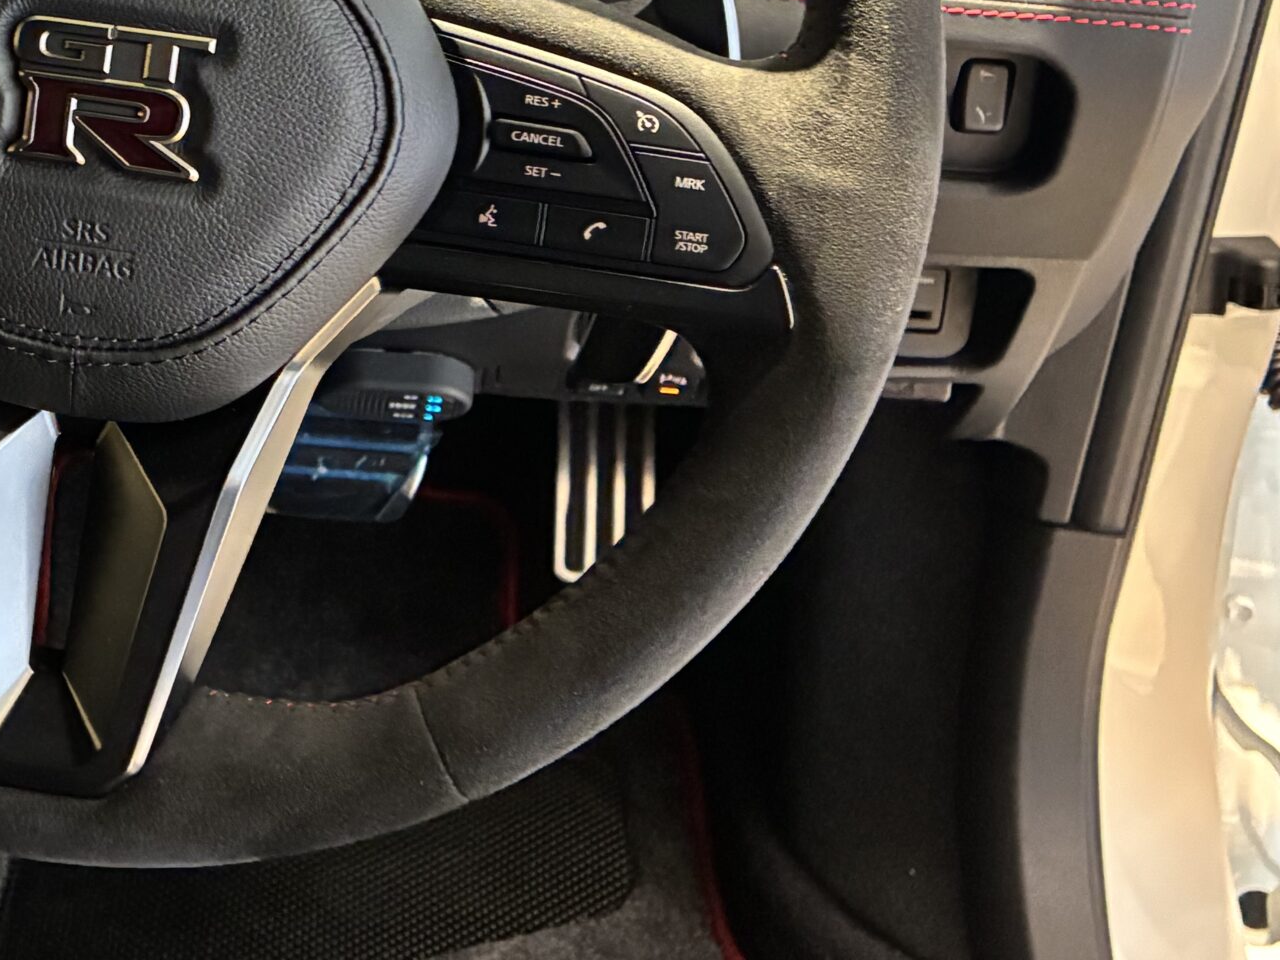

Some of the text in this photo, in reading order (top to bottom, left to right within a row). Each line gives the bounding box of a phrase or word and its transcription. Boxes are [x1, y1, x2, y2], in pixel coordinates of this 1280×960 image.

[511, 130, 564, 148] CANCEL
[675, 176, 706, 191] MRK
[62, 219, 112, 243] SRS
[675, 230, 709, 243] START
[675, 241, 709, 254] /STOP
[31, 246, 137, 279] AIRBAG
